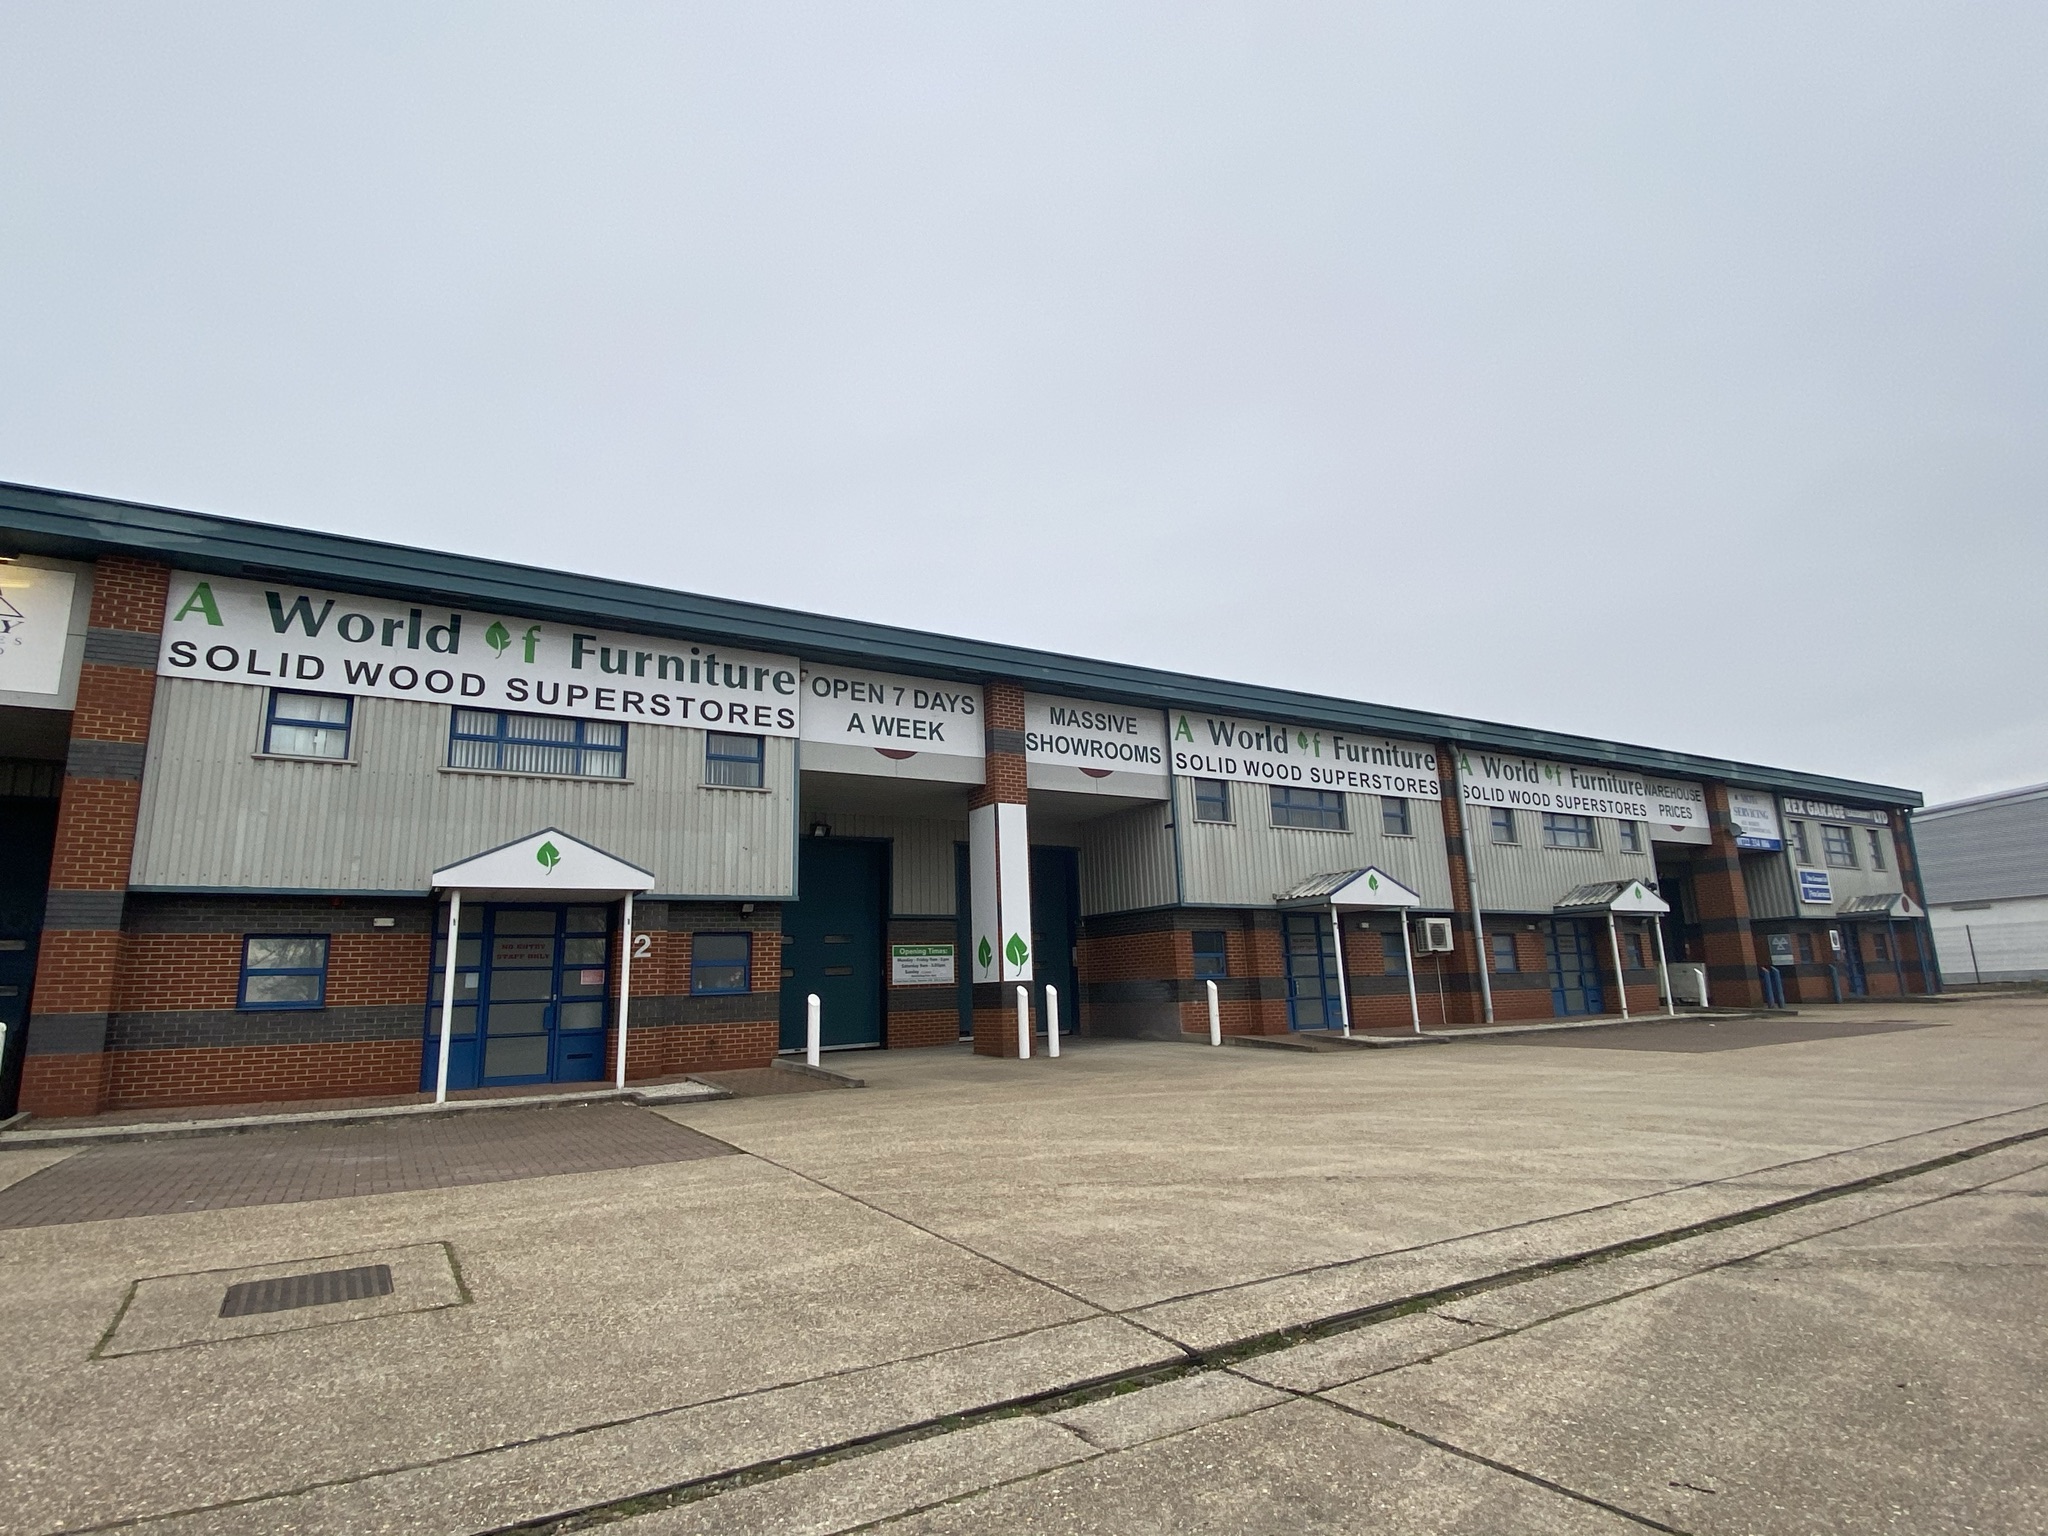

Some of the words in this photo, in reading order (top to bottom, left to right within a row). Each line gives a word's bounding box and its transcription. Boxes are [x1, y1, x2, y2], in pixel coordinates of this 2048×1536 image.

[173, 582, 224, 627] A
[264, 591, 461, 655] World
[570, 633, 796, 695] Furniture
[167, 641, 325, 681] SOLID
[344, 659, 486, 698] WOOD
[506, 677, 796, 730] SUPERSTORES
[812, 676, 885, 705] OPEN
[892, 687, 906, 707] 7
[913, 690, 976, 715] DAYS
[846, 712, 866, 734] A
[873, 714, 946, 743] WEEK
[1049, 706, 1138, 736] MASSIVE
[1026, 732, 1162, 765] SHOWROOMS
[1174, 714, 1194, 744] A
[1206, 718, 1289, 755] World
[1332, 736, 1436, 773] Furniture
[1175, 752, 1237, 775] SOLID
[1243, 760, 1303, 782] WOOD
[1310, 767, 1439, 796] SUPERSTORES
[1459, 752, 1474, 776] A
[1481, 755, 1540, 784] World
[1570, 767, 1643, 796] Furniture
[1463, 784, 1505, 803] SOLID
[1508, 789, 1551, 808] WOOD
[1556, 795, 1647, 817] SUPERSTORES
[1644, 782, 1702, 802] WAREHOUSE
[1784, 798, 1806, 814] REX
[1806, 800, 1846, 819] GARAGE
[1659, 803, 1693, 820] PRICES
[1733, 806, 1769, 820] SERVICING
[633, 934, 651, 958] 2
